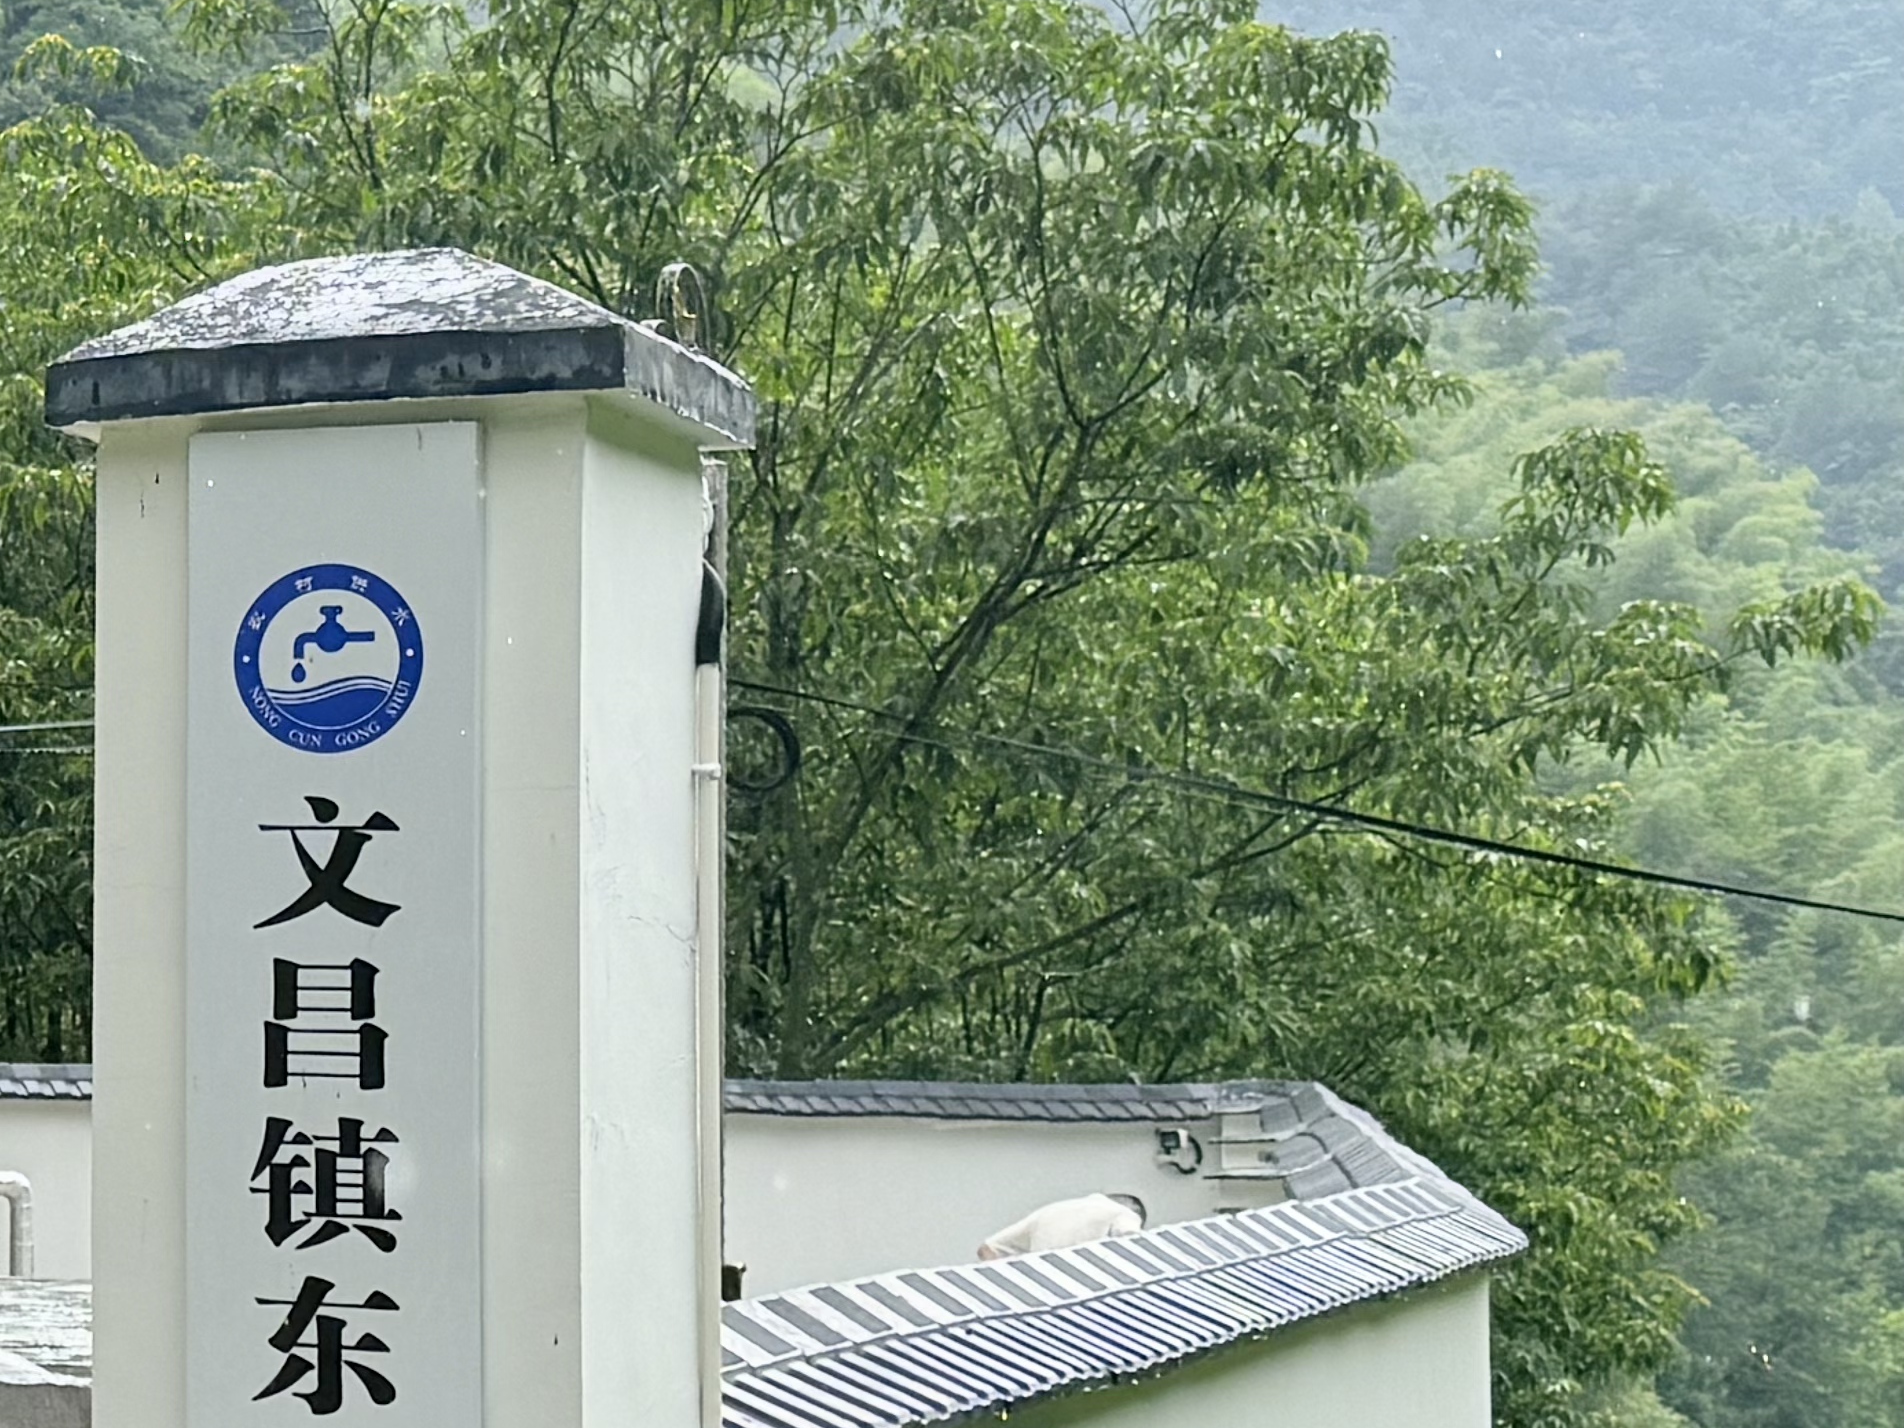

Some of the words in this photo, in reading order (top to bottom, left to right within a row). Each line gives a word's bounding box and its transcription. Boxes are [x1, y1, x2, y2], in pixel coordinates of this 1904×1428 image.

[249, 684, 282, 728] NONG
[288, 729, 323, 747] CUN
[335, 721, 381, 747] GONG
[386, 679, 412, 718] SHUI
